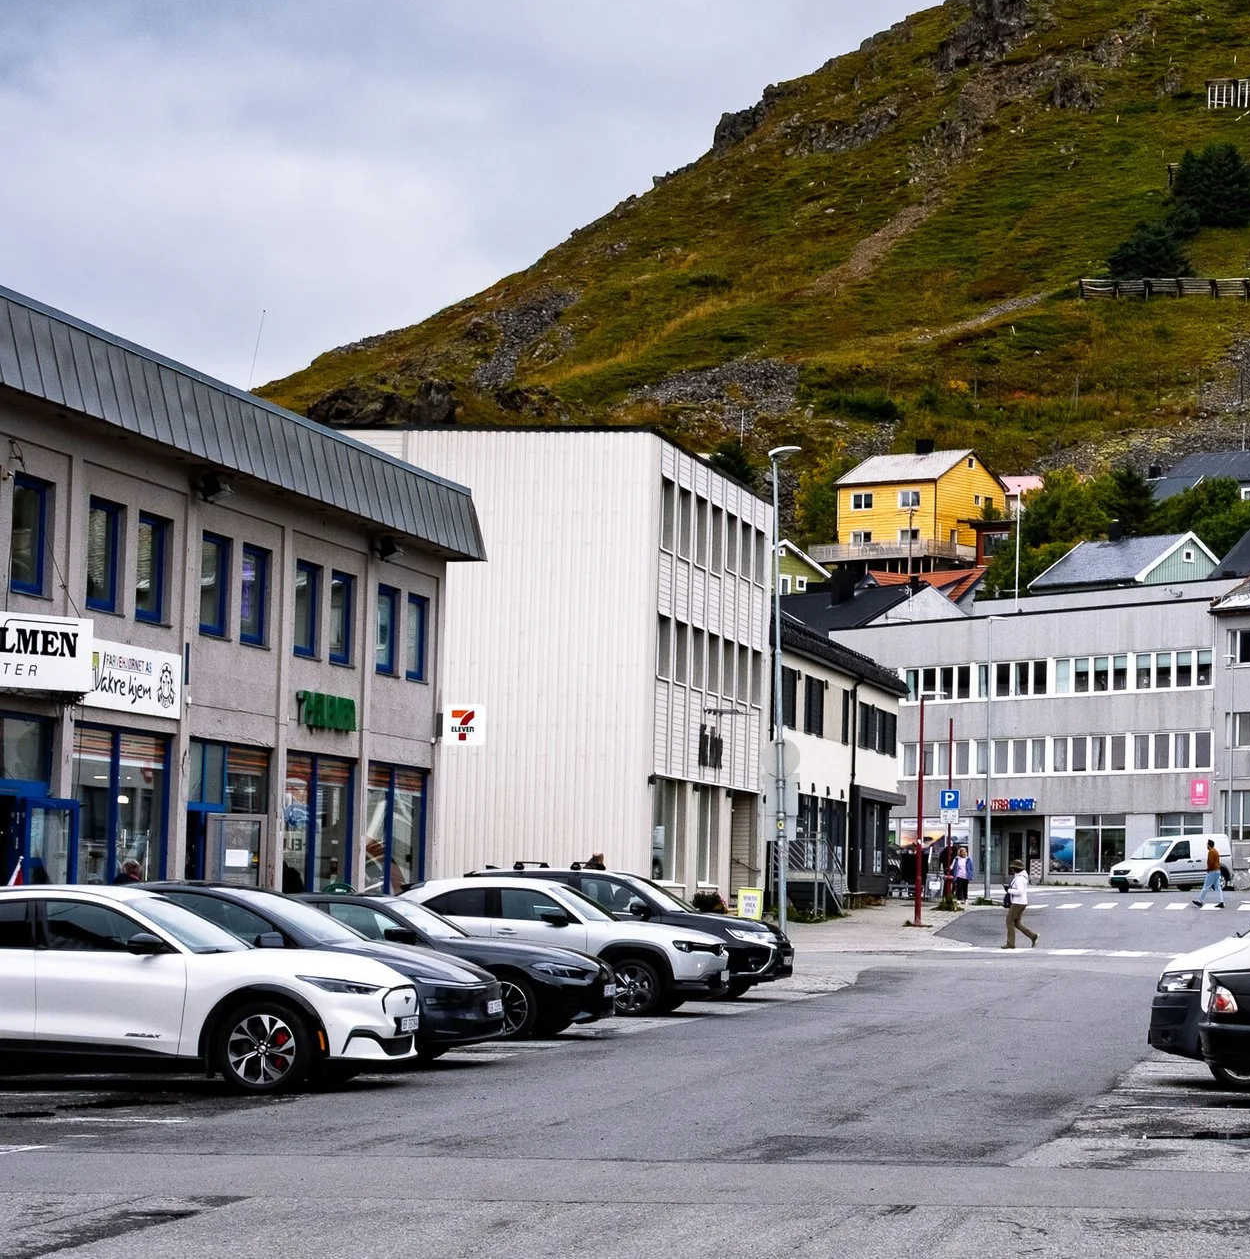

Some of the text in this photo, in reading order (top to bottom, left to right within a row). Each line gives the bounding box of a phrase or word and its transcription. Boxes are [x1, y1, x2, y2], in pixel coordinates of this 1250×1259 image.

[145, 660, 153, 674] AS
[94, 650, 153, 704] Vakre hjem
[944, 792, 956, 807] P
